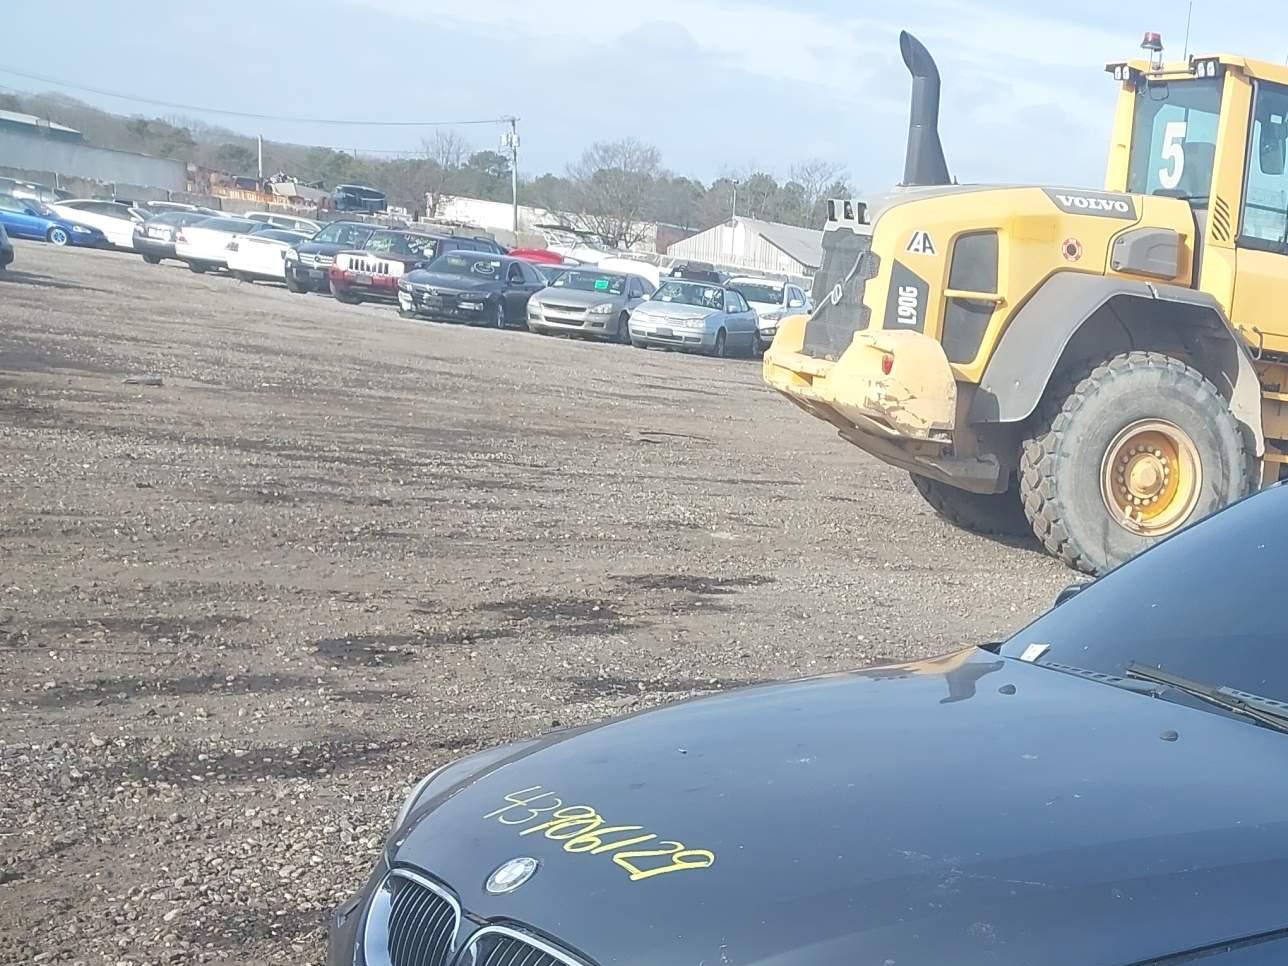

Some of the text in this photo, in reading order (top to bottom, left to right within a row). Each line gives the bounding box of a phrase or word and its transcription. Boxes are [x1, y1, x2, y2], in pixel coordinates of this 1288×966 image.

[1159, 122, 1187, 189] 5
[1056, 194, 1129, 213] VOLVO
[897, 286, 919, 325] L90G
[483, 785, 716, 881] 43906129
